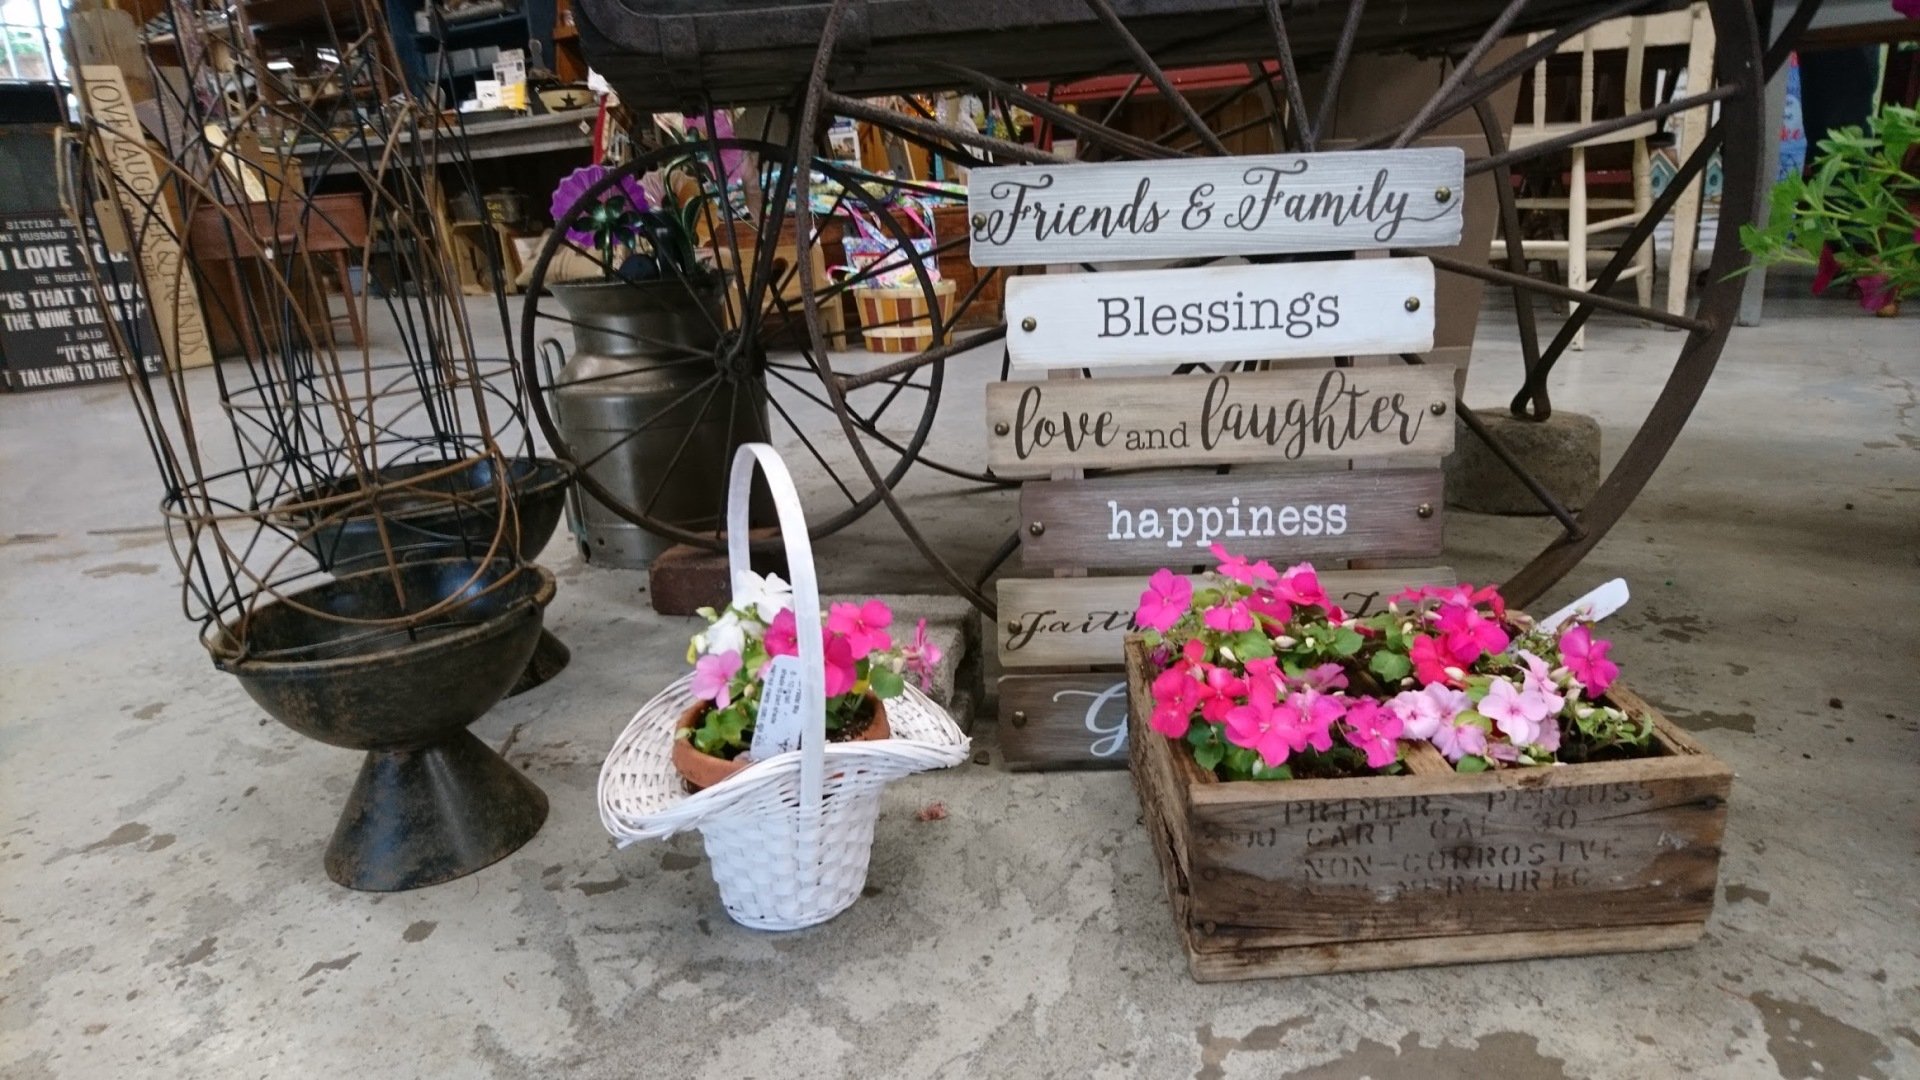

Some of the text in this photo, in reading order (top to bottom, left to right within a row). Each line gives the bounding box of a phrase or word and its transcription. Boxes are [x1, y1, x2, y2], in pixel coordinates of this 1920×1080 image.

[973, 159, 1460, 246] Friends & Family
[6, 219, 54, 230] SITTING
[19, 231, 67, 241] HUSBAND
[11, 246, 73, 270] LOVE
[29, 288, 75, 308] THAT
[1, 310, 34, 332] THE
[35, 308, 75, 329] WINE
[1097, 291, 1340, 339] Blessings
[76, 329, 103, 341] SAID
[18, 364, 75, 388] TALKING
[77, 362, 95, 381] TO
[95, 358, 122, 379] THE
[1014, 369, 1425, 461] love and laughter
[1107, 497, 1347, 547] happiness
